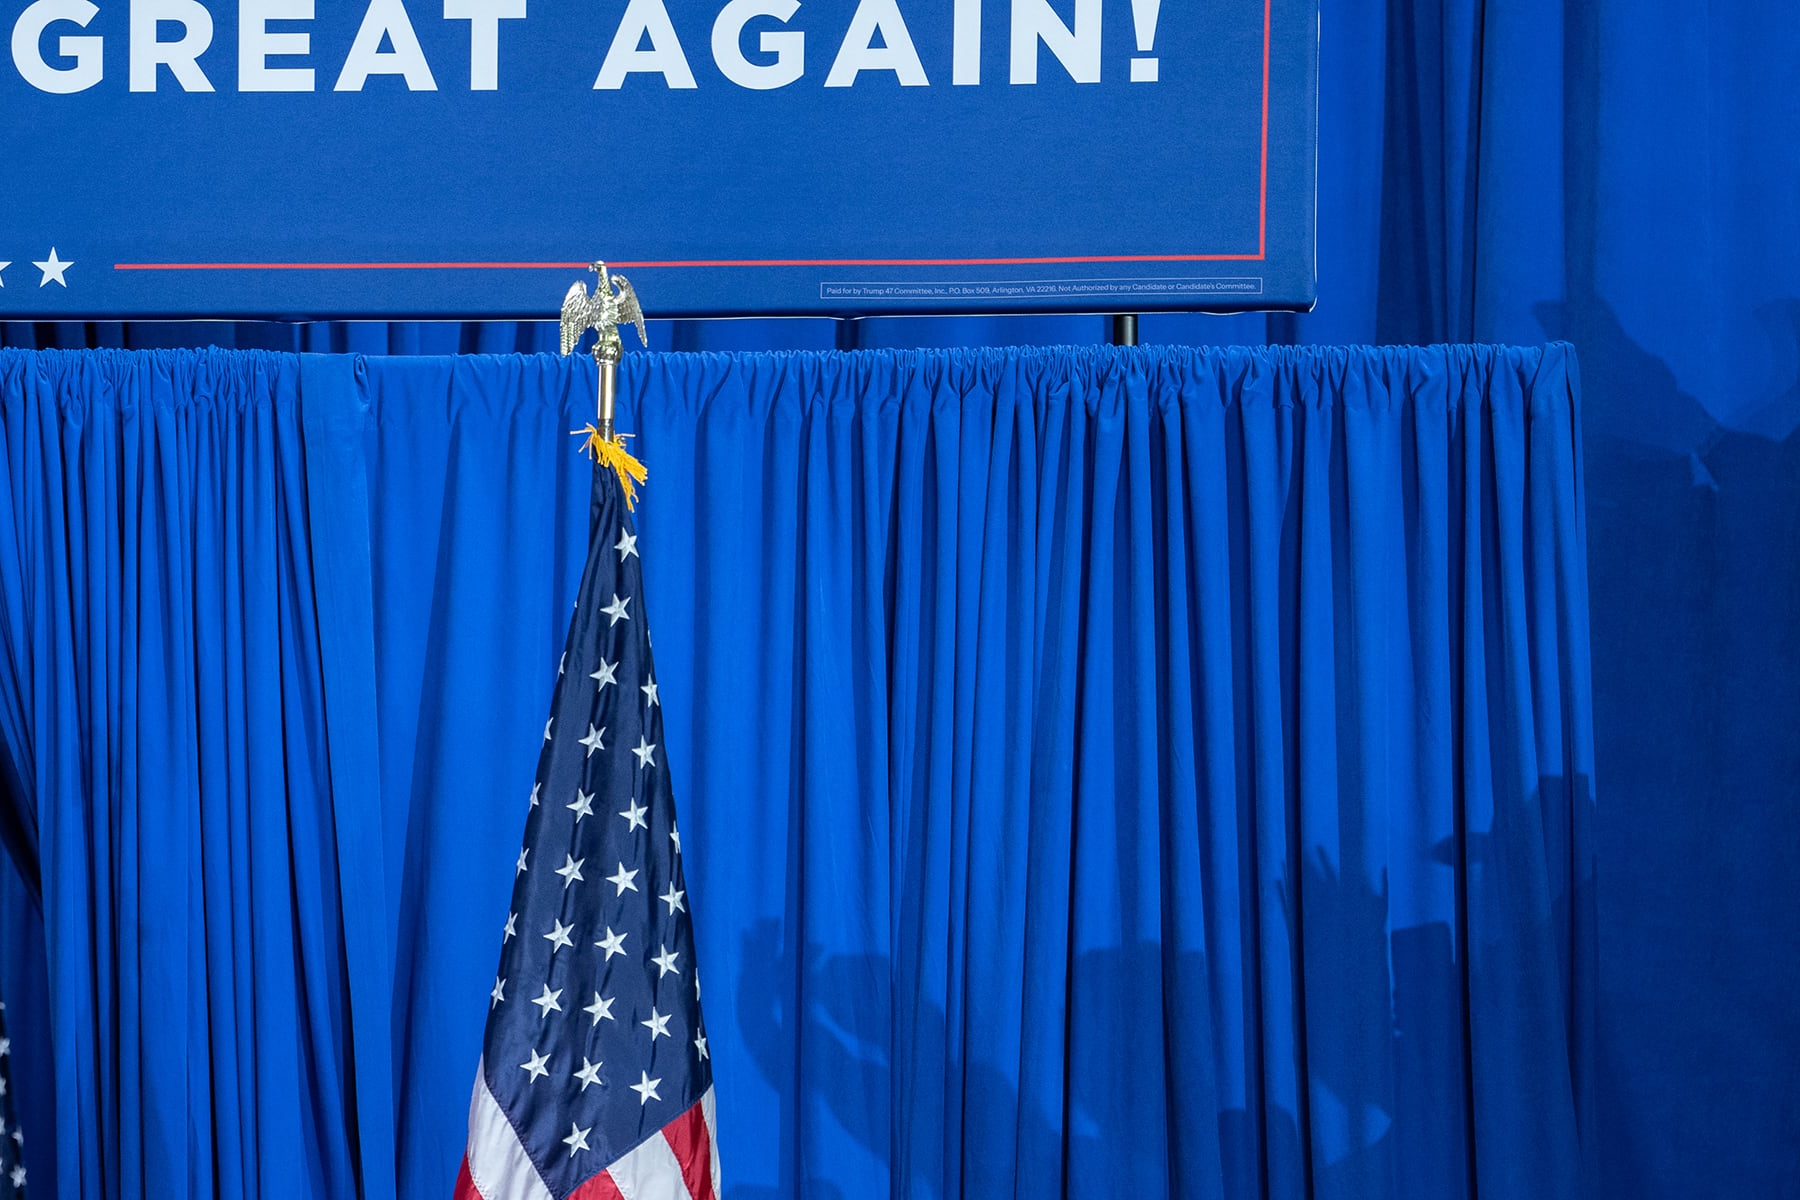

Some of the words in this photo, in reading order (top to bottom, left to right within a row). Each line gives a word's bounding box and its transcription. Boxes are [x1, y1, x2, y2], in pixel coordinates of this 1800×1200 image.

[12, 0, 526, 93] GREAT
[593, 0, 1160, 89] AGAIN!
[853, 287, 862, 295] by
[863, 287, 884, 295] Trump
[1072, 284, 1108, 292] Authorized
[1110, 284, 1118, 292] by
[1119, 284, 1131, 292] any
[1216, 282, 1256, 290] Committee.
